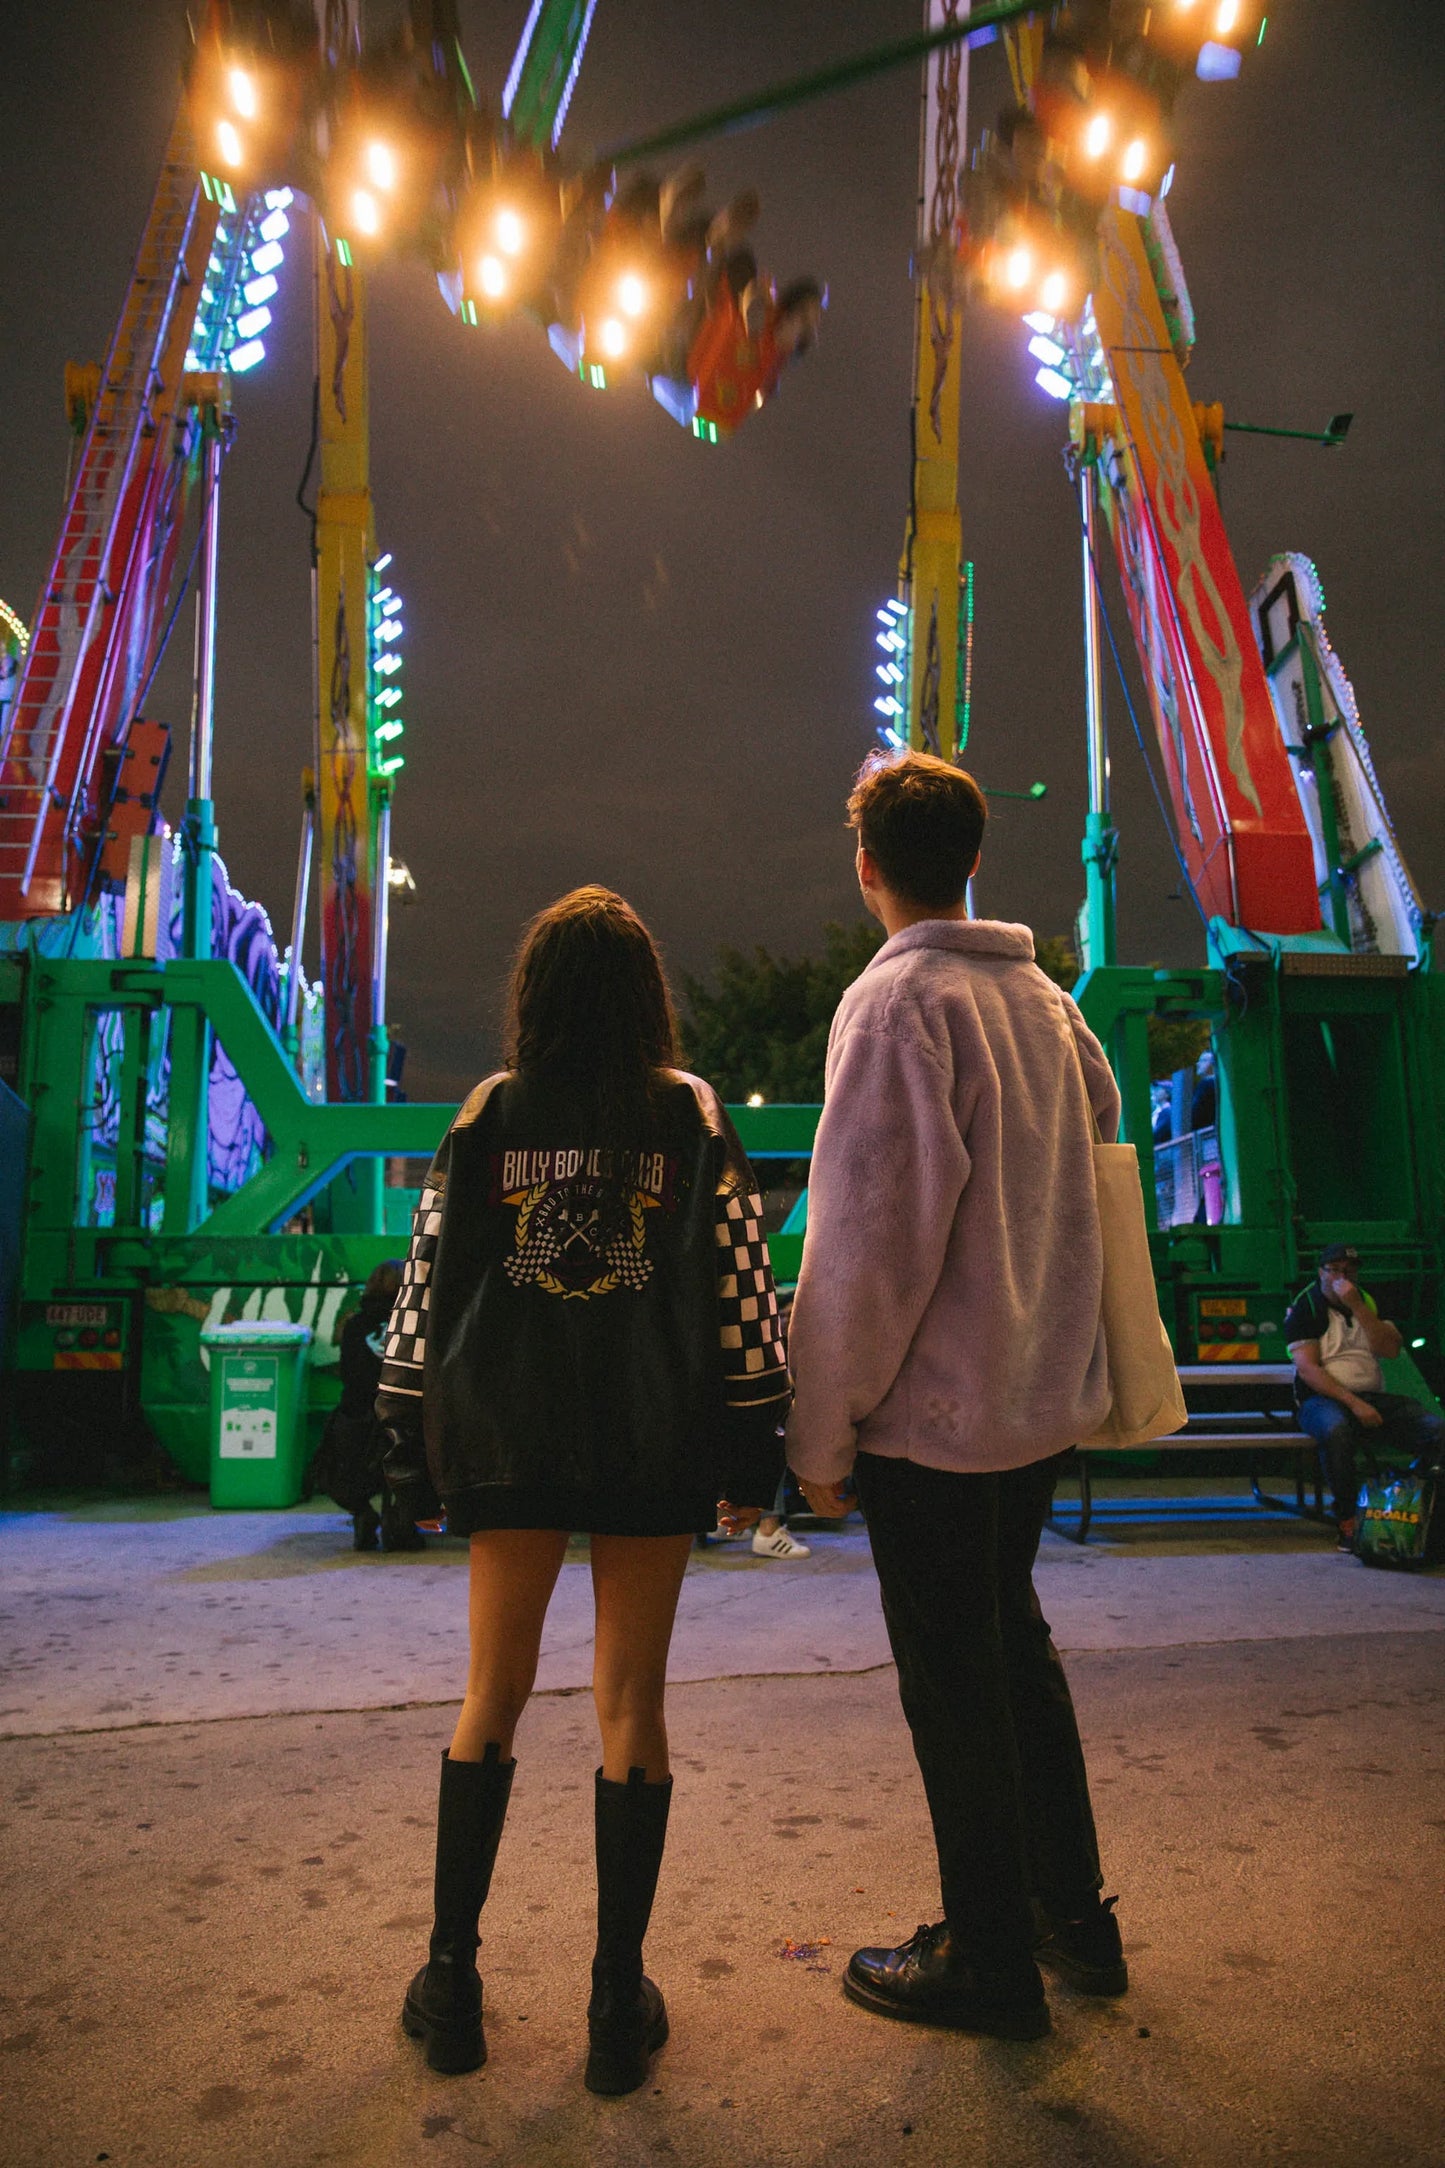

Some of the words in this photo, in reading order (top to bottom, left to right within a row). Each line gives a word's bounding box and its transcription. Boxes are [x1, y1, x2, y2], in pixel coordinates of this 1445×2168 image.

[502, 1149, 551, 1191] BILLY
[554, 1148, 613, 1181] BONE
[621, 1149, 665, 1195] UB
[538, 1196, 557, 1217] BAD
[575, 1184, 594, 1195] THE
